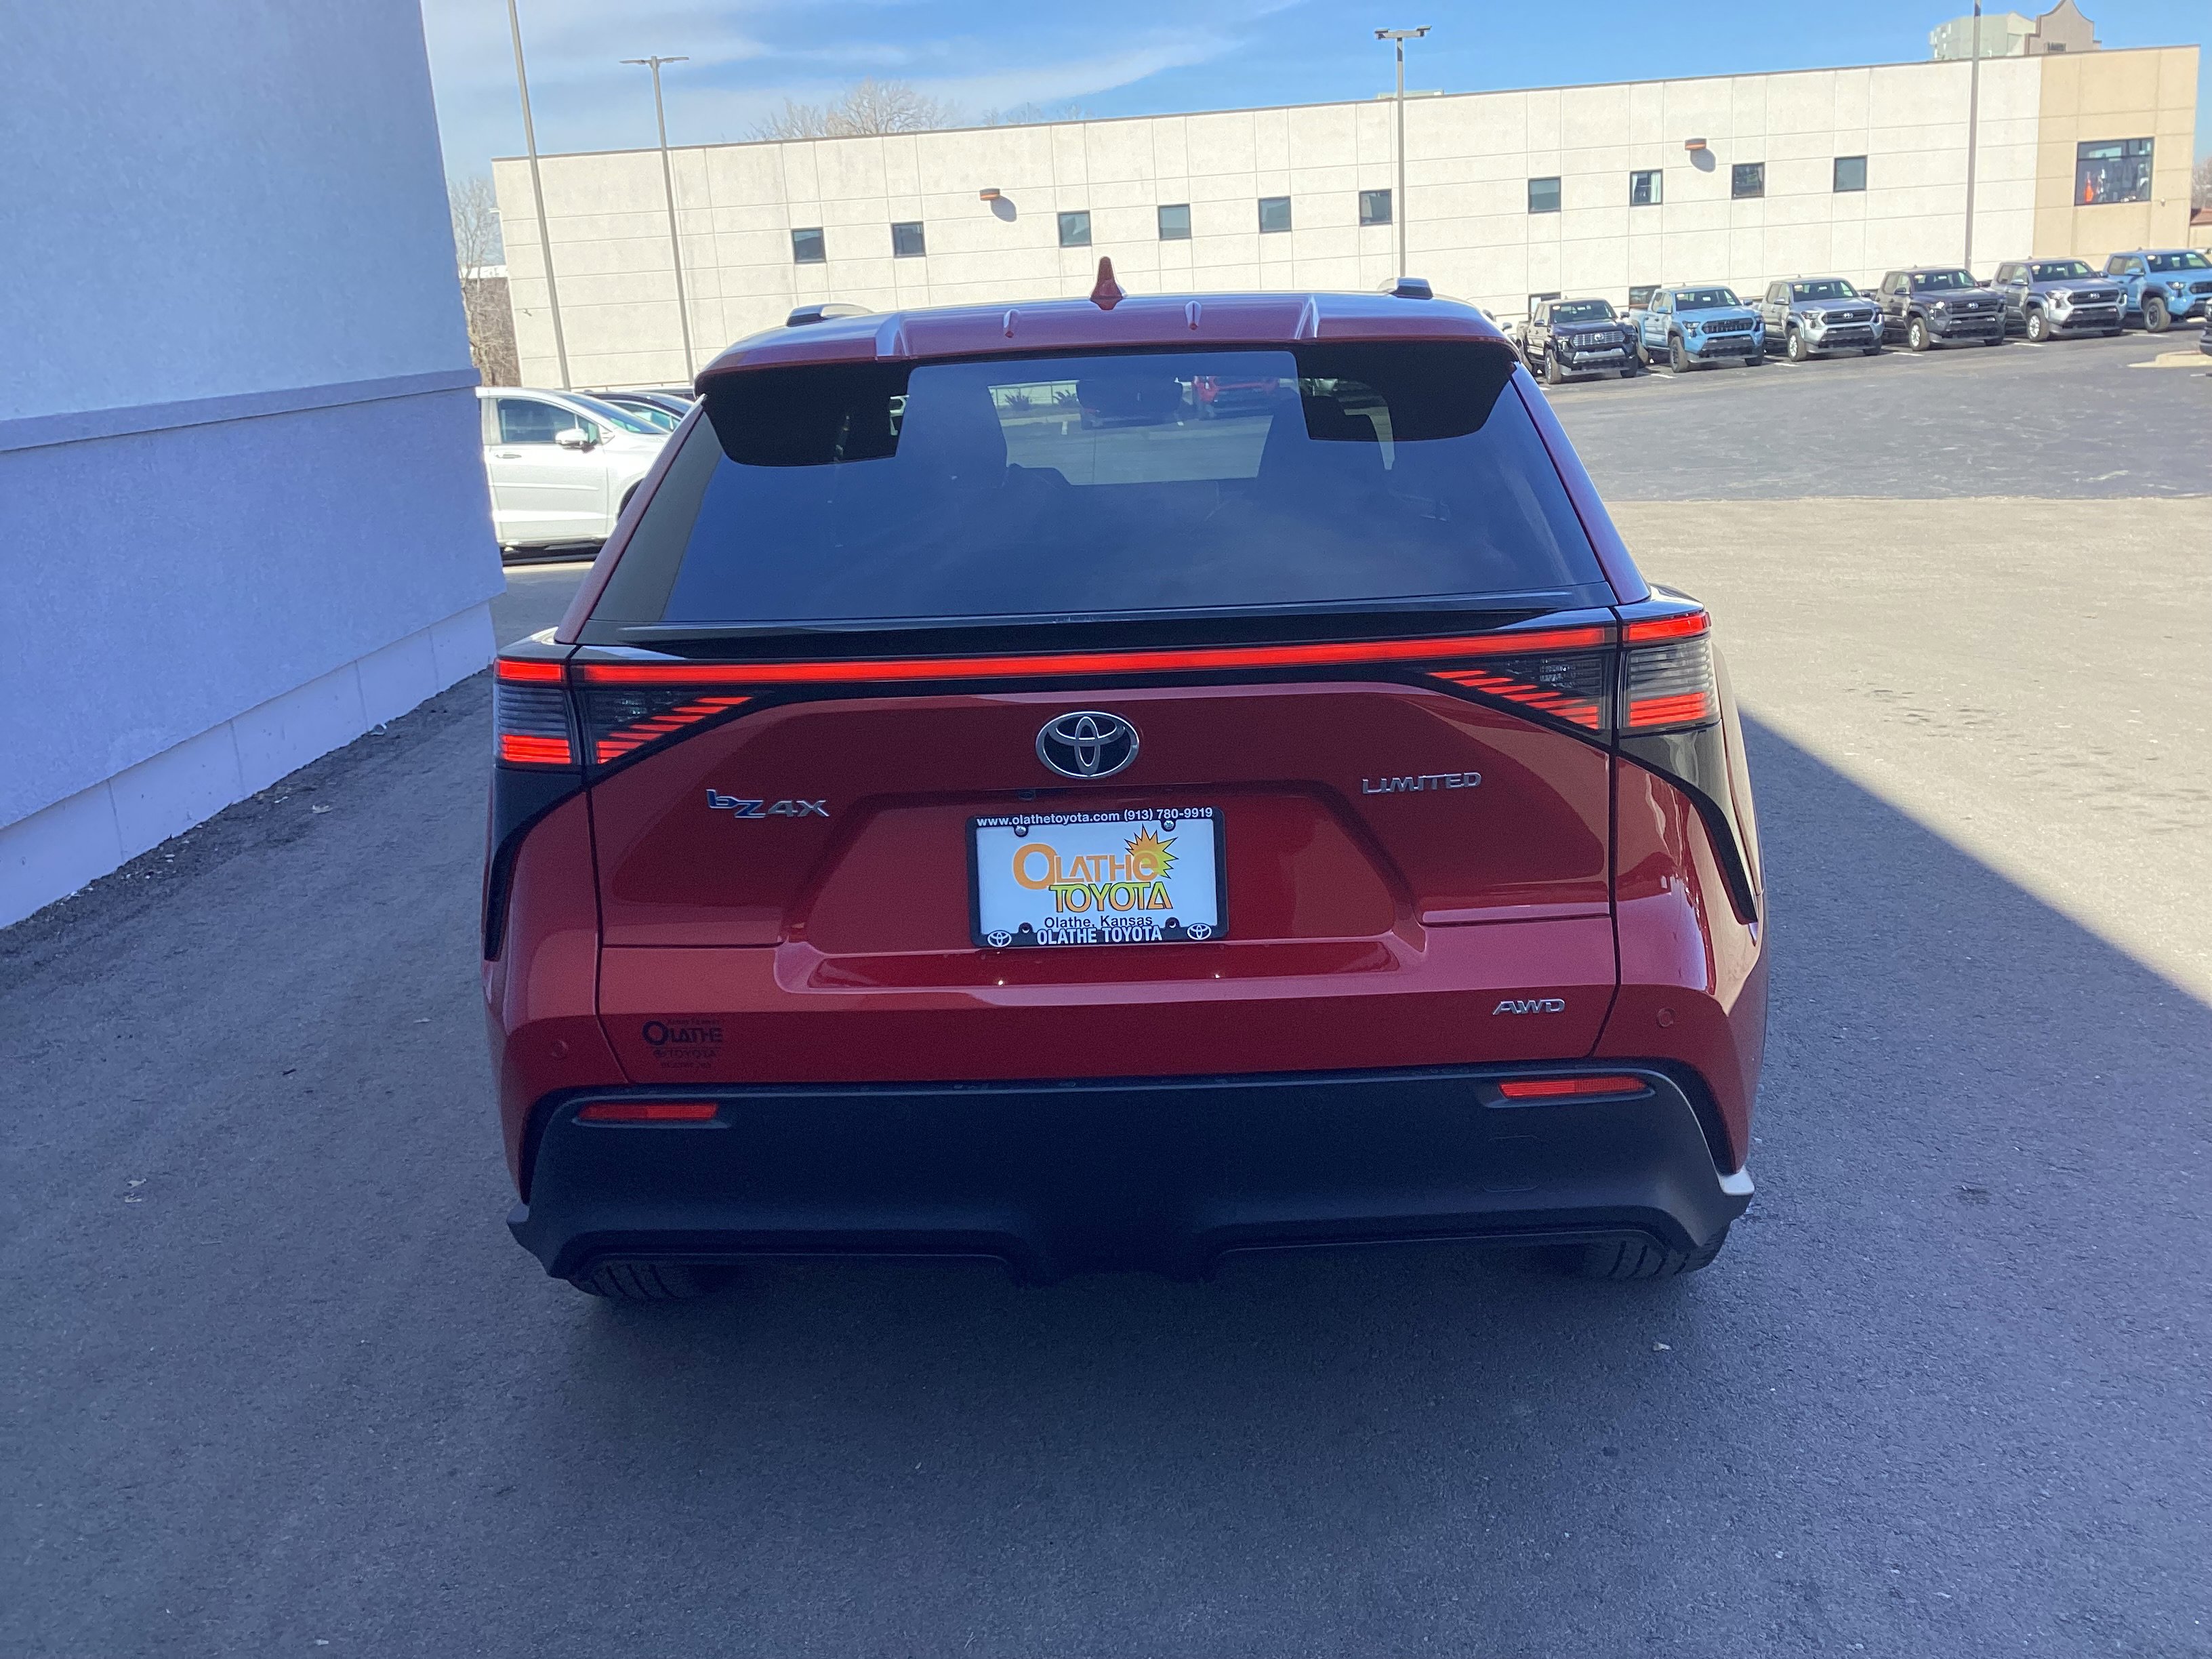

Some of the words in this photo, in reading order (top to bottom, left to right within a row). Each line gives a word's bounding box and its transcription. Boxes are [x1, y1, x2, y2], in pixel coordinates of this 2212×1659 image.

[1361, 771, 1482, 794] LIMITED
[977, 811, 1120, 827] www.olathetoyota.com
[1124, 809, 1153, 822] (913)
[1156, 807, 1213, 819] 780-9919
[1049, 881, 1173, 913] TOYOTA
[1100, 914, 1153, 927] Kansas
[1036, 927, 1097, 945] OLATHE
[1101, 924, 1162, 943] TOYOTA
[1492, 998, 1565, 1016] AWD
[642, 1021, 722, 1046] OLATHE
